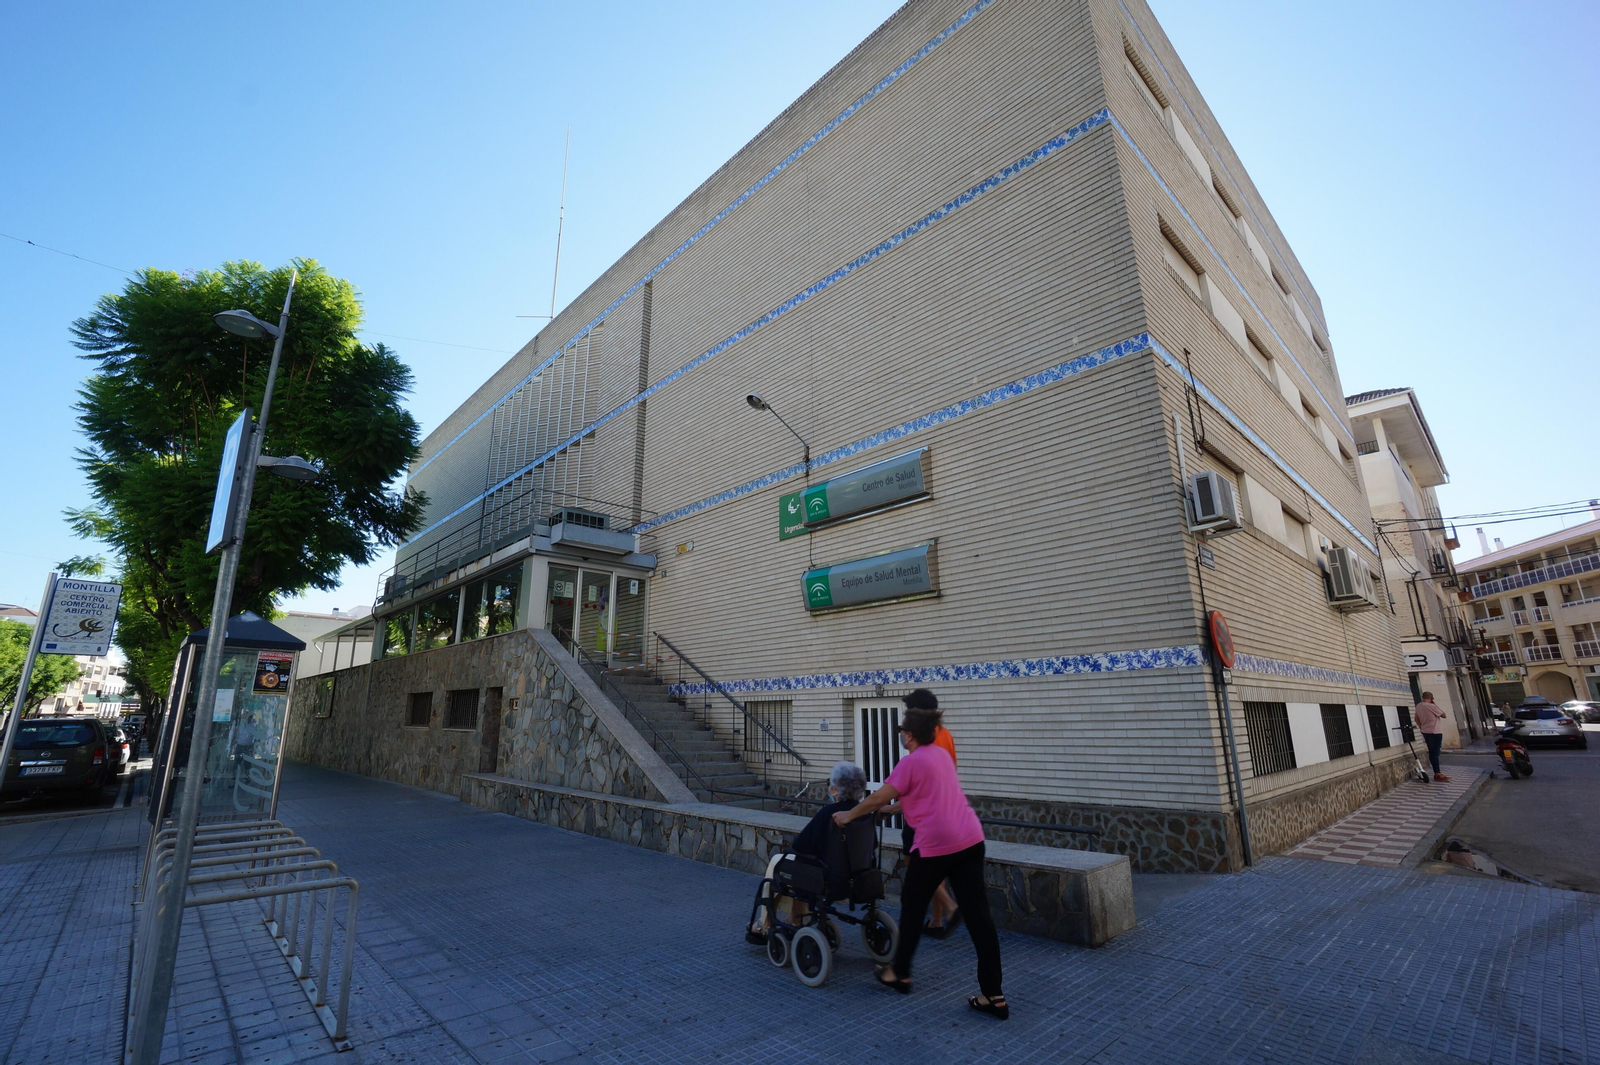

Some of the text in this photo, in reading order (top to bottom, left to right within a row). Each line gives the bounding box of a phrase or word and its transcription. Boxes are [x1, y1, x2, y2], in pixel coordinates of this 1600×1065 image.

[862, 468, 916, 492] Centro de Salud
[898, 480, 918, 490] Montilla
[841, 564, 922, 589] Equipo de Salud Mental
[902, 577, 923, 585] Montilla
[62, 582, 116, 593] MONTILLA
[69, 594, 105, 602] CENTRO
[60, 600, 110, 609] COMERCIAL
[65, 607, 103, 615] ABIERTO
